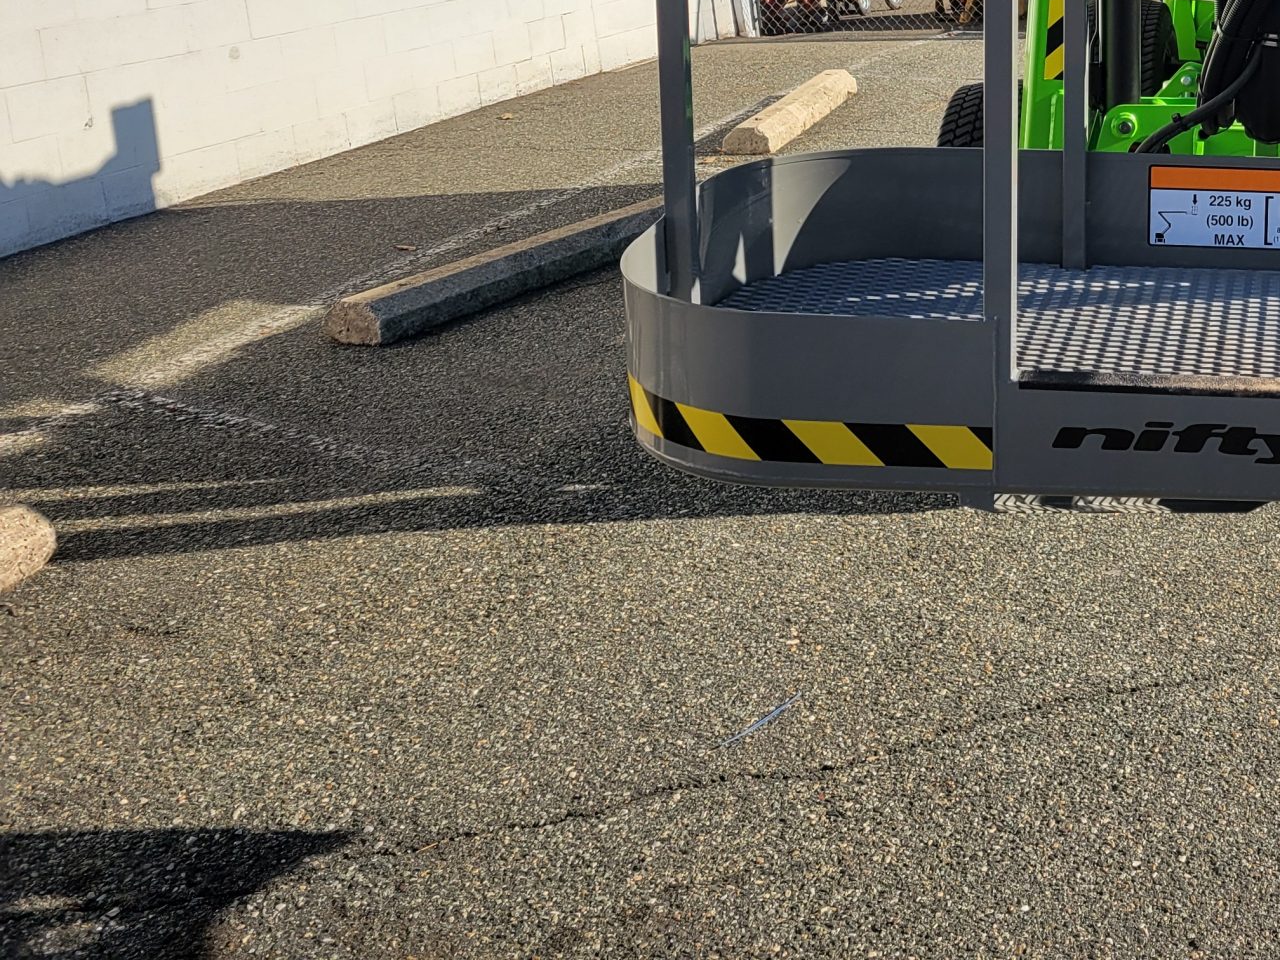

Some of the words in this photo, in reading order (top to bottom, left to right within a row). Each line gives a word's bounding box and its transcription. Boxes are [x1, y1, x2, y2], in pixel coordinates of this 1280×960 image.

[1208, 195, 1232, 207] 225
[1236, 195, 1252, 211] kg
[1206, 214, 1234, 229] (500
[1237, 215, 1254, 230] lb)
[1214, 233, 1245, 246] MAX
